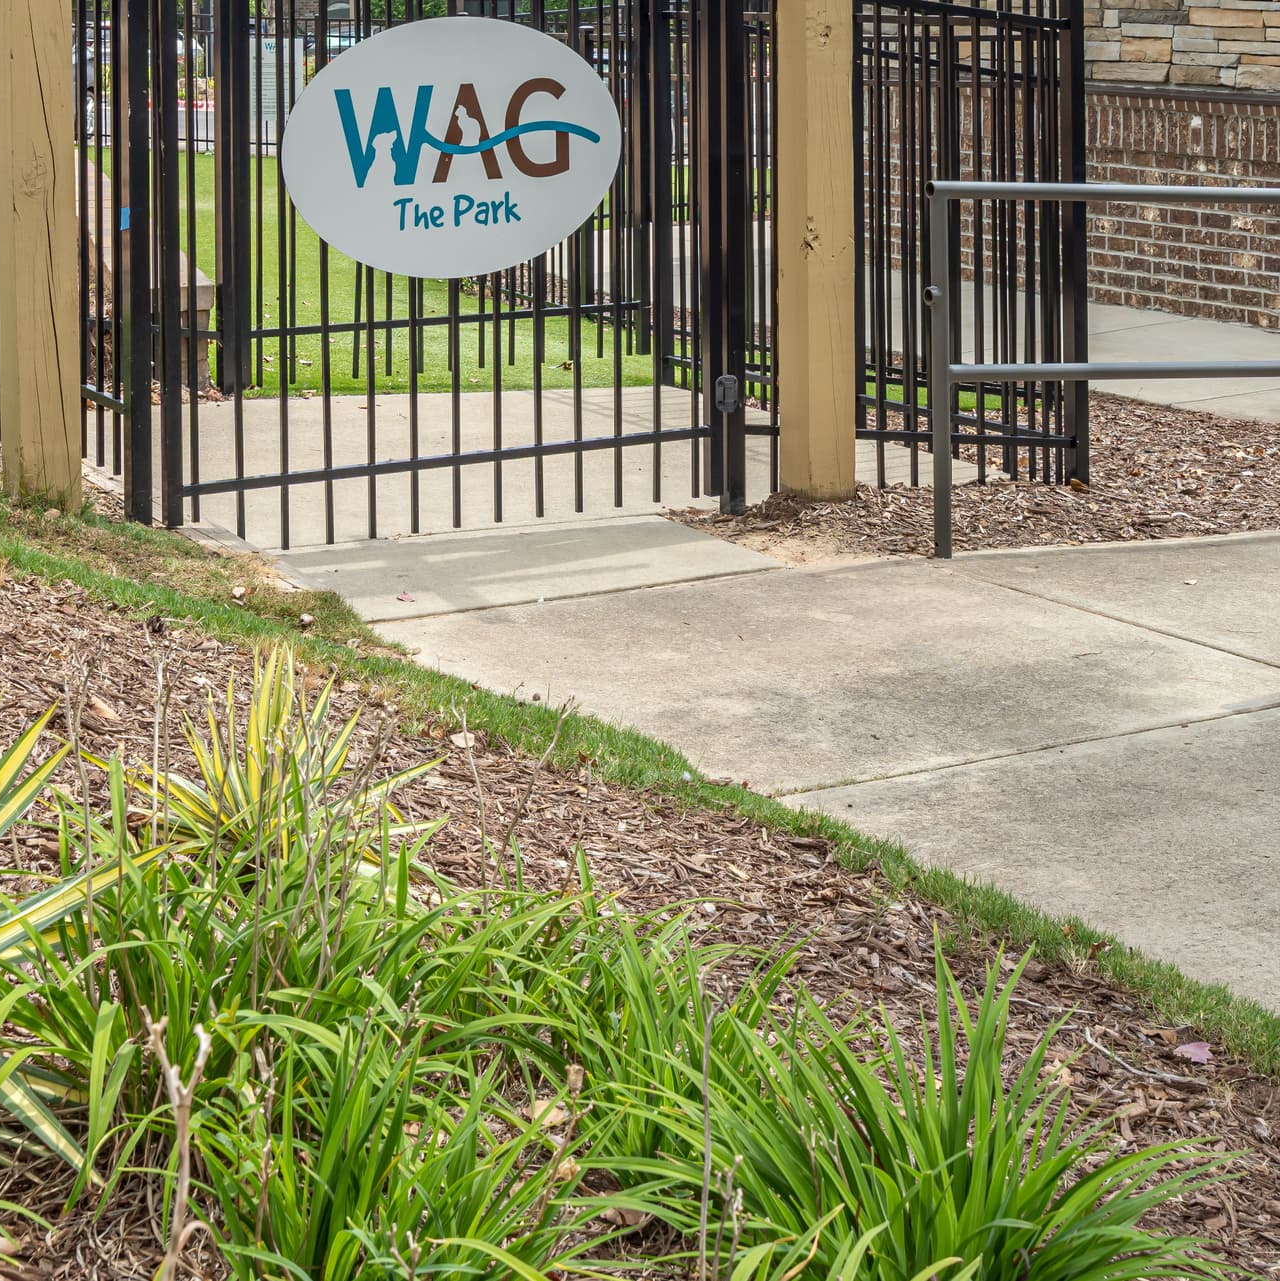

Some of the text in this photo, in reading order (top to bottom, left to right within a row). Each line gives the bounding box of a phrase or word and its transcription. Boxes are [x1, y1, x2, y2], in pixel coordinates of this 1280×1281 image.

[334, 77, 570, 188] WAG
[393, 191, 522, 231] The Park
